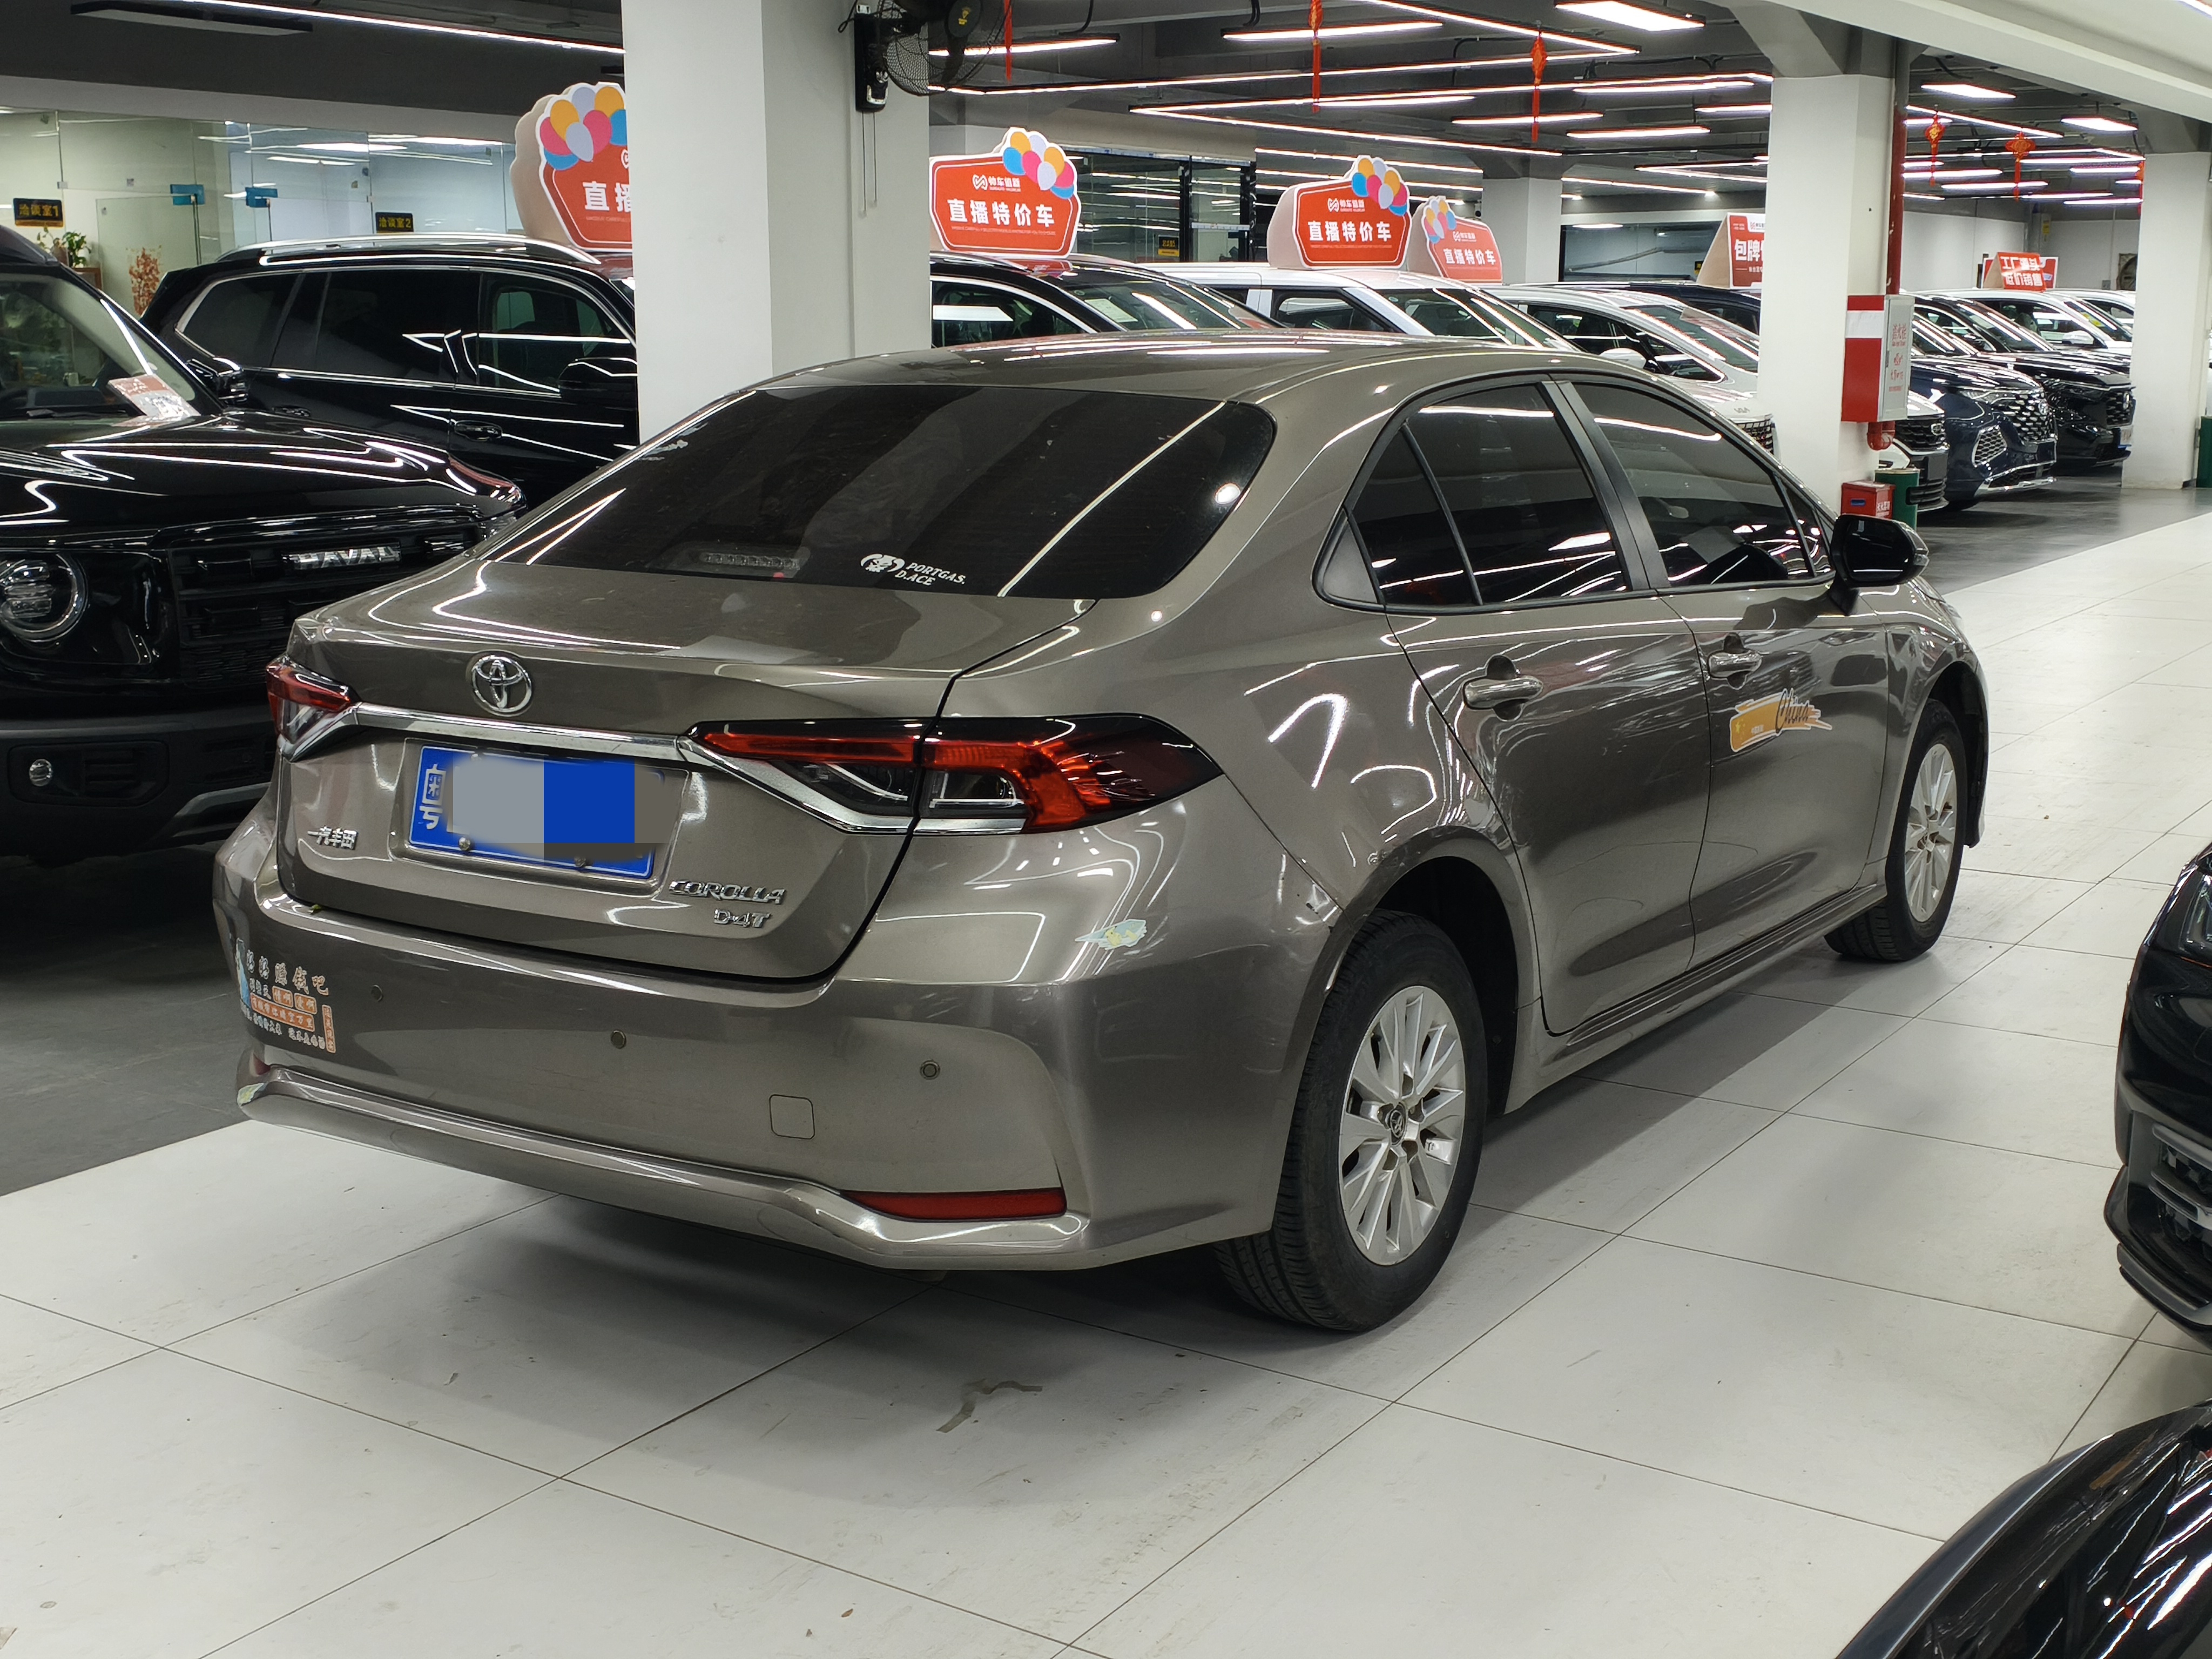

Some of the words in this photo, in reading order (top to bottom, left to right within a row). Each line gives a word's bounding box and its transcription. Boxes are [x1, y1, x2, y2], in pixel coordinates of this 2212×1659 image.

[947, 198, 1055, 228] 直播特价车
[1307, 220, 1392, 242] 直播特价车
[1443, 248, 1496, 265] 直播特价车
[288, 545, 401, 571] HAVAL
[894, 570, 936, 586] D.ACE
[906, 562, 966, 585] PORTGAS.
[668, 880, 786, 905] COROLLA
[713, 908, 772, 928] D-4T
